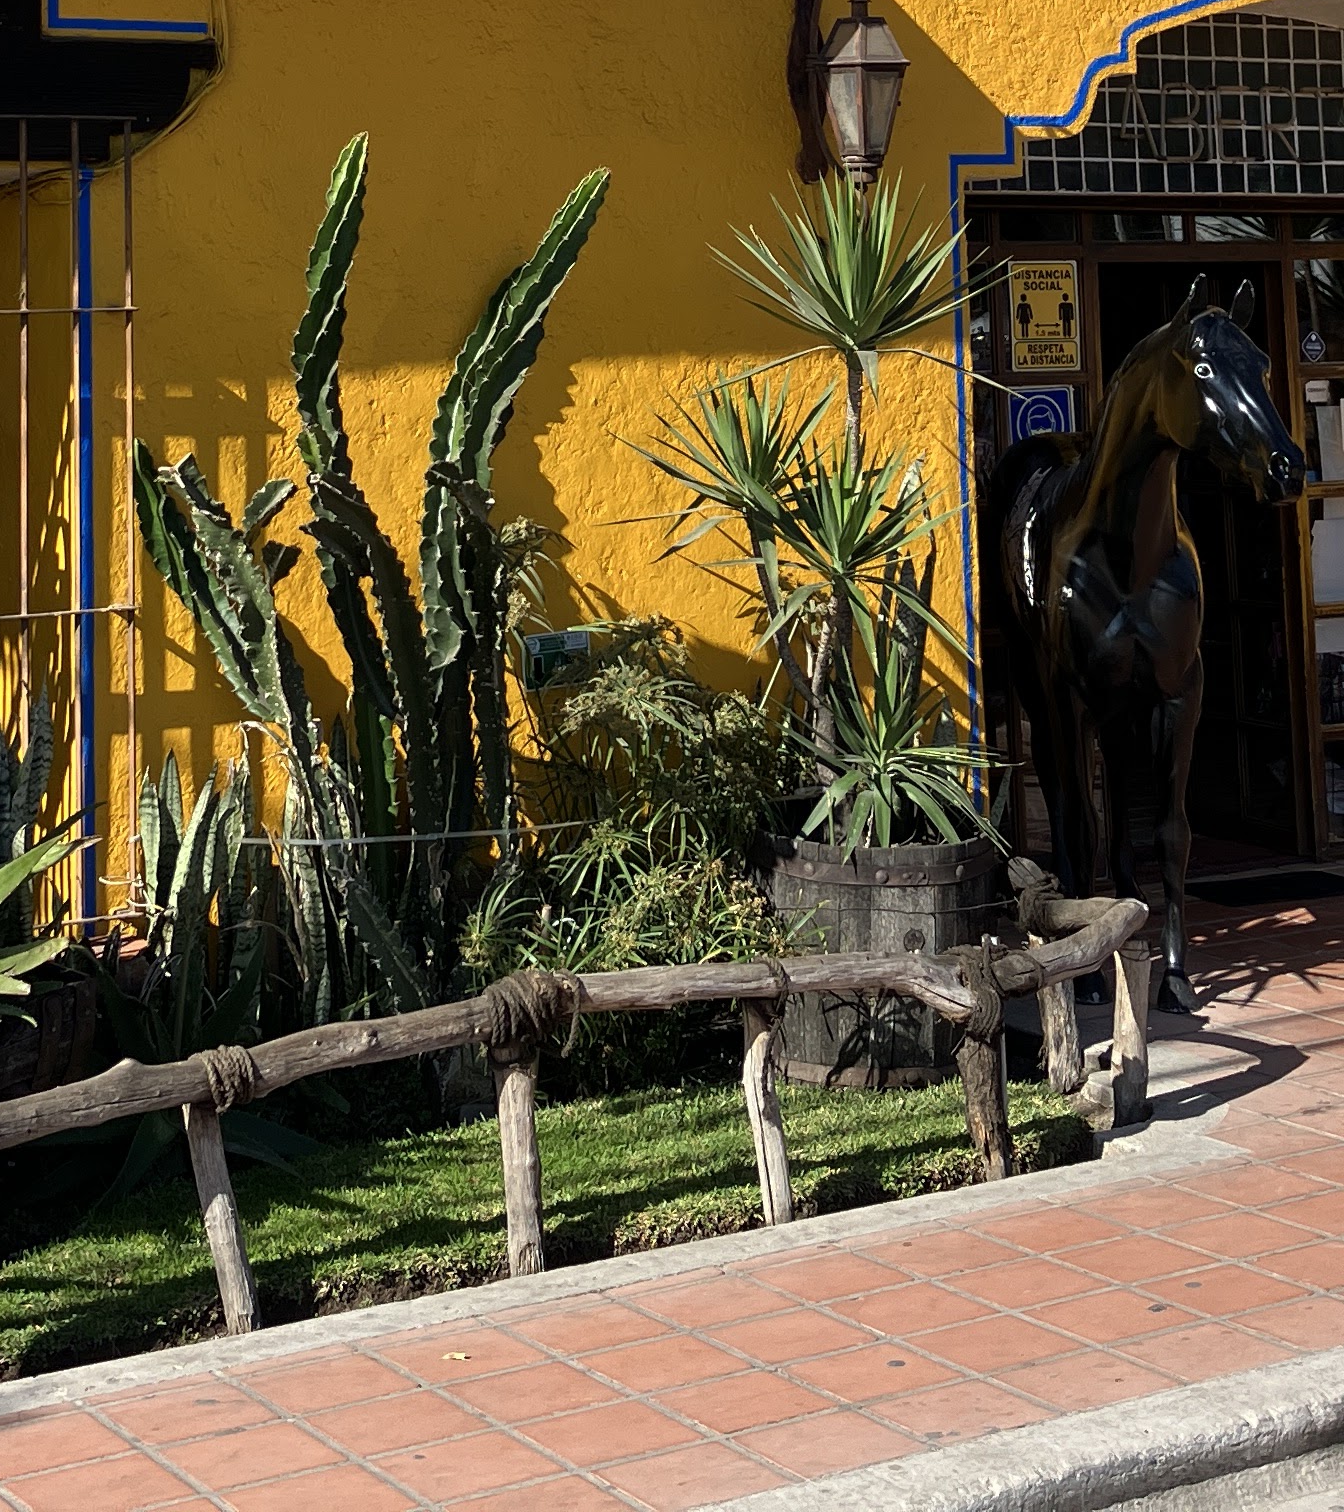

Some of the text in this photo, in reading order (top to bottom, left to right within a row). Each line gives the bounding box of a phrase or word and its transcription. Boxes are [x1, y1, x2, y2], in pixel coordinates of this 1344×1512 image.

[1014, 269, 1071, 280] DISTANCIA
[1023, 281, 1063, 291] SOCIAL
[1027, 344, 1065, 354] RESPETA
[1017, 354, 1075, 366] LA DISTANCIA
